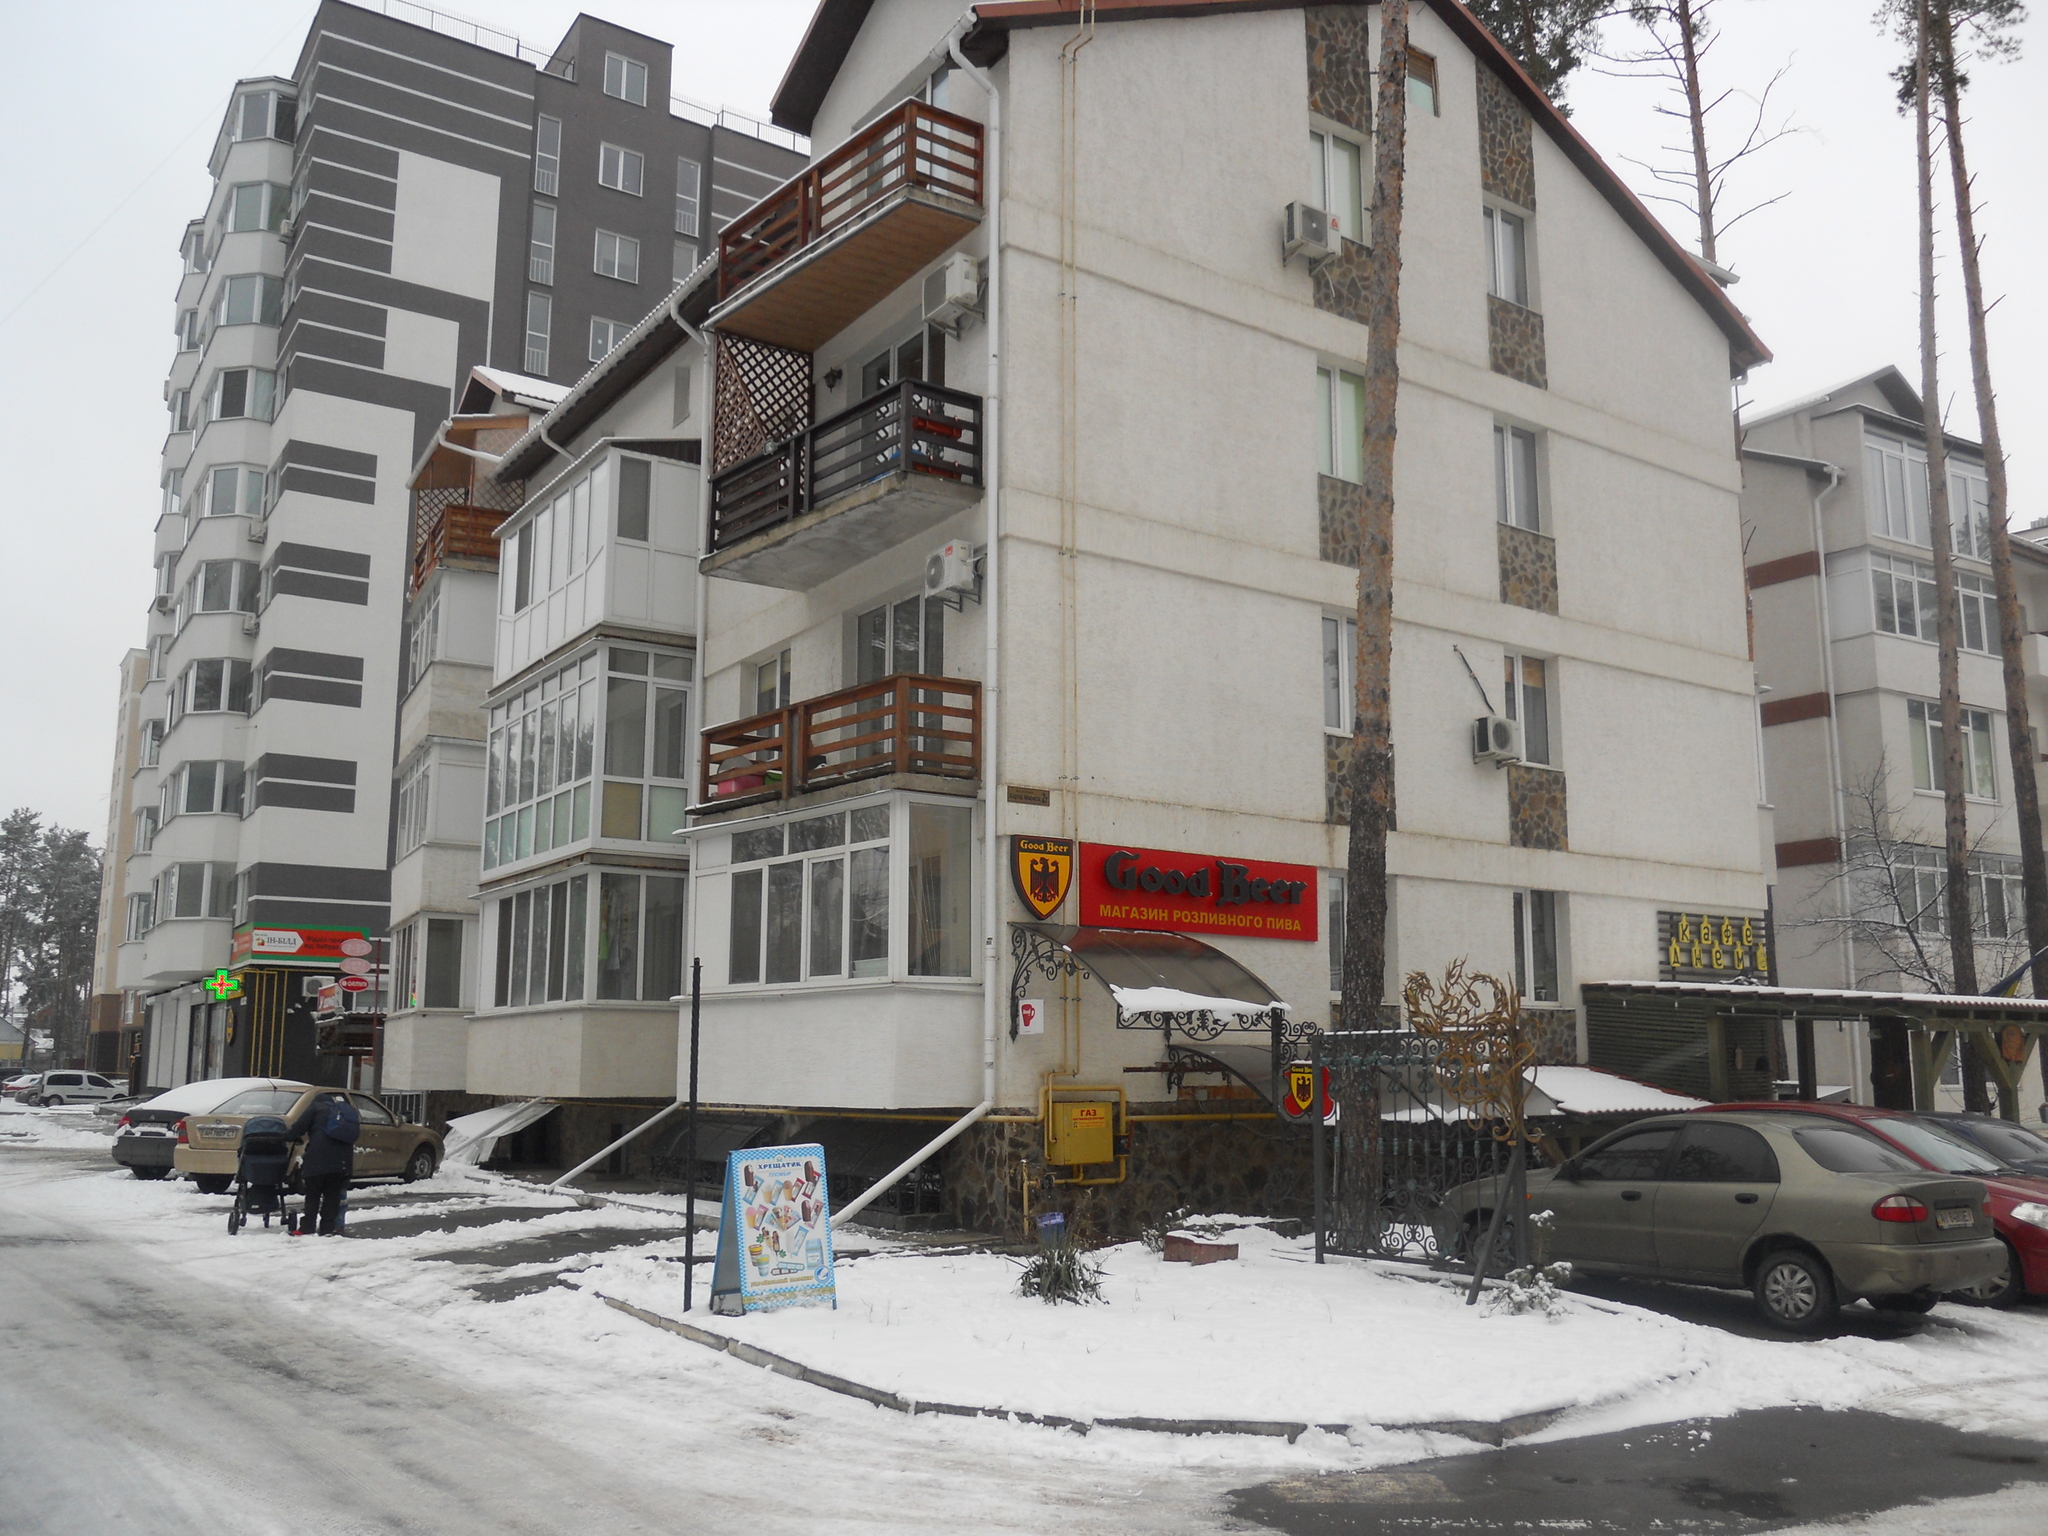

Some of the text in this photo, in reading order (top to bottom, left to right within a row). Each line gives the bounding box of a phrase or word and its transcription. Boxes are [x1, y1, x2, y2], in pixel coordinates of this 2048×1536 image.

[1019, 840, 1070, 853] Good Beer
[1104, 850, 1309, 908] Good Beer
[1099, 903, 1303, 932] МАГАЗИН РОЗЛИВНОГО ПИВА
[1080, 1109, 1098, 1117] ГАЗ
[757, 1161, 803, 1170] ХРЕЩАТИК
